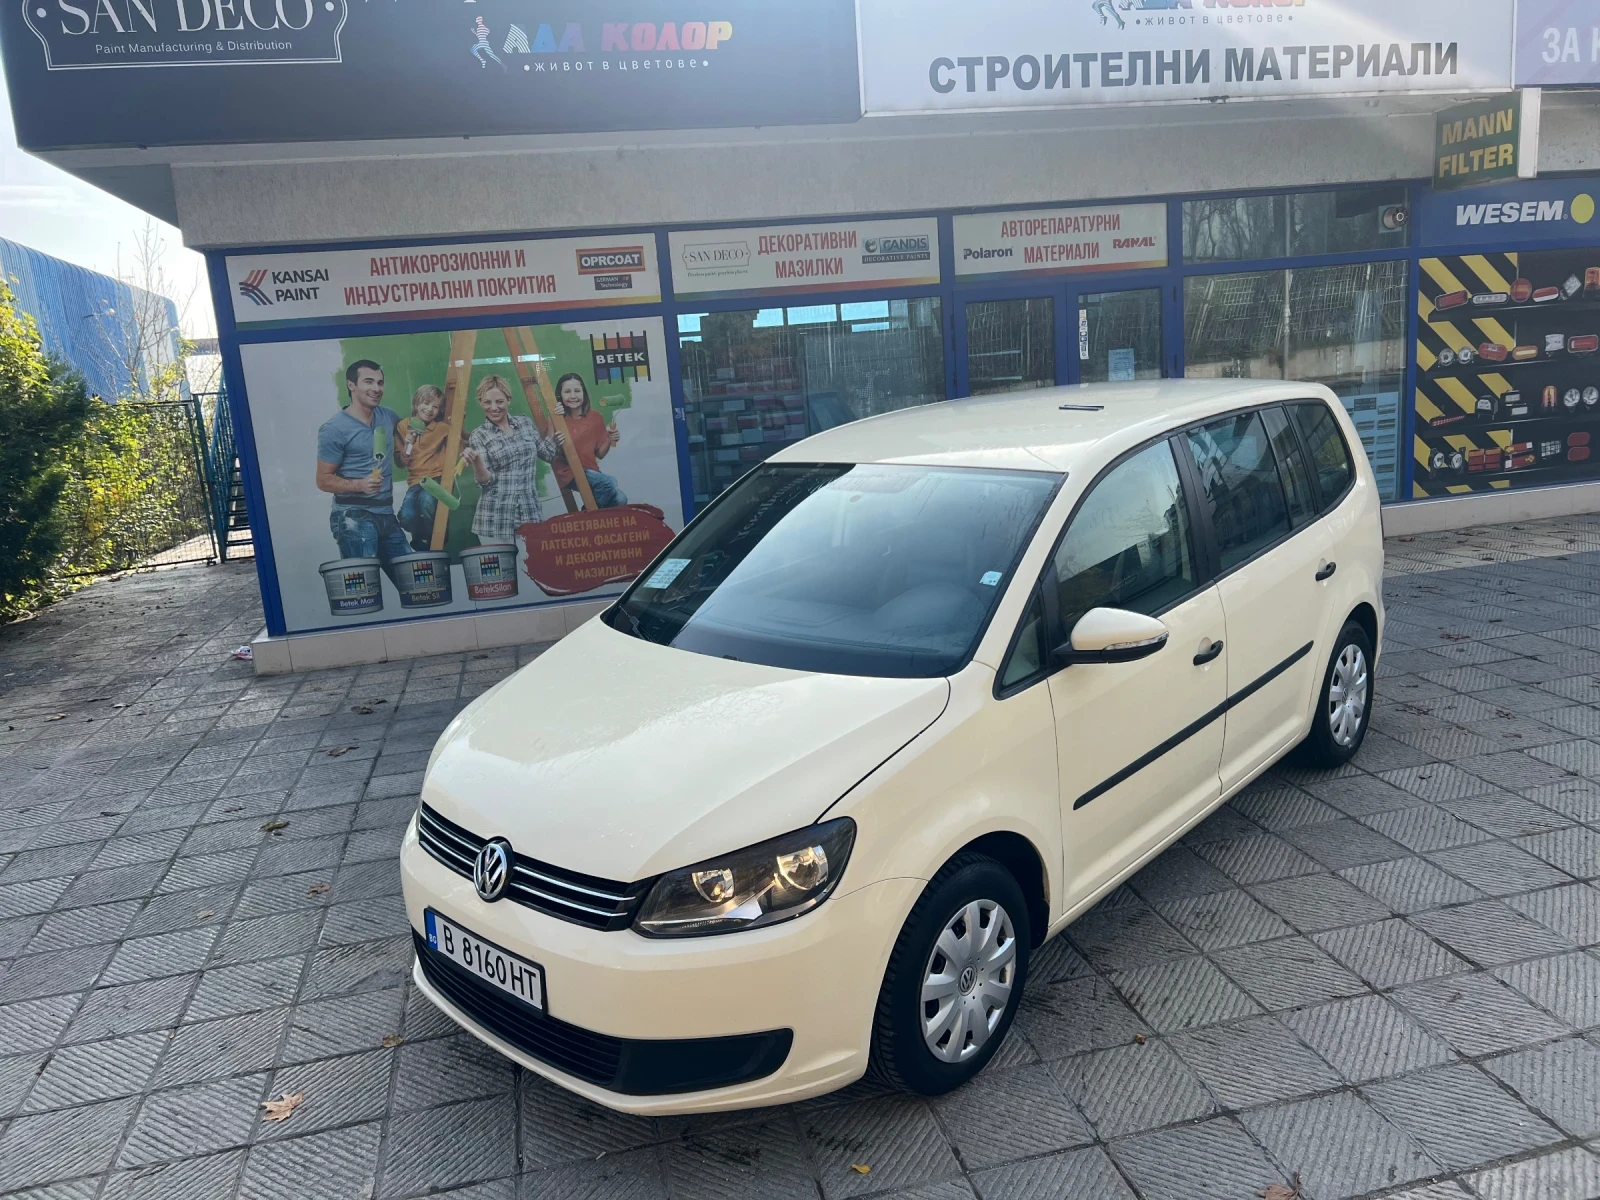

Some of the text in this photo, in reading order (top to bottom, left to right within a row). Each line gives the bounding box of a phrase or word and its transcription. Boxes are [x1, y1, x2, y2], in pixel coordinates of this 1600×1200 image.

[61, 0, 314, 35] SAN DECO
[95, 40, 292, 54] Paint Manufacturing & Distribution
[1541, 27, 1581, 64] ЗА
[928, 42, 1458, 94] СТРОИТЕЛНИ МАТЕРИАЛИ
[1442, 108, 1513, 146] MANN
[1438, 143, 1514, 178] FILTER
[1456, 200, 1564, 226] WESEM
[1001, 214, 1121, 238] АВТОРЕПАРАТУРНИ
[758, 231, 857, 255] ДЕКОРАТИВНИ
[1024, 242, 1100, 263] МАТЕРИАЛИ
[1113, 236, 1156, 249] RANAL
[369, 248, 526, 277] АНТИКОРОЗИОННИ И
[581, 254, 640, 267] OPRCOAT
[689, 250, 744, 263] SAN DECO
[864, 252, 929, 262] DECORATIVE PAINTS
[964, 247, 1013, 260] Polaron
[272, 269, 329, 284] KANSAI
[775, 257, 844, 279] МАЗИЛКИ
[275, 286, 320, 302] PAINT
[344, 275, 557, 307] ИНДУСТРИАЛНИ ПОКРИТИЯ
[596, 352, 645, 364] BETEK
[551, 516, 637, 534] ОЦВЕТЯВАНЕ НА
[541, 530, 650, 551] ЛАТЕКСИ, ФАСАГЕНИ
[555, 547, 643, 566] И ДЕКОРАТИВНИ
[574, 565, 627, 580] МАЗИЛКИ
[411, 594, 431, 602] Betek
[429, 933, 437, 944] BG
[443, 924, 537, 1001] B 8160 HT
